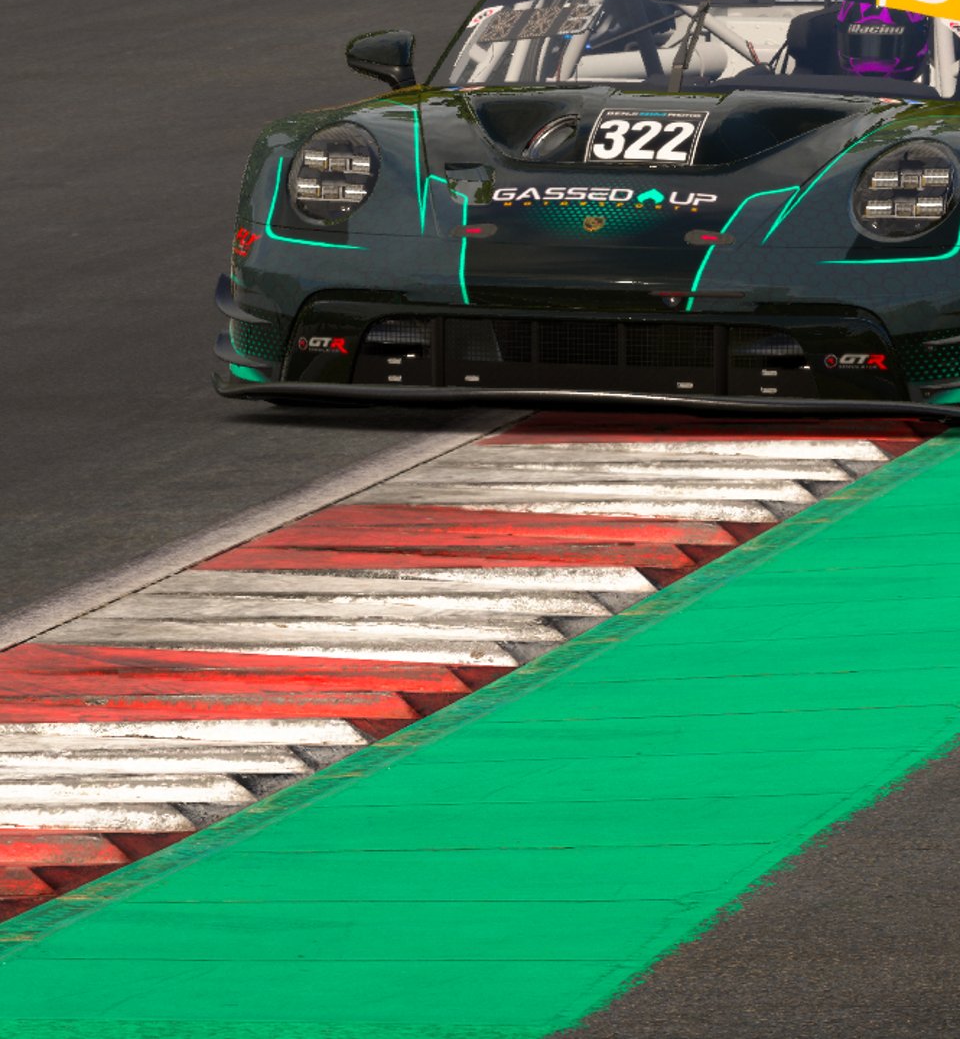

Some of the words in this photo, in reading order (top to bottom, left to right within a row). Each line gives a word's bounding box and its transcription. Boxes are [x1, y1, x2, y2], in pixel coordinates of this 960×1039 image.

[847, 23, 905, 36] iRacing
[592, 119, 697, 162] 322
[491, 186, 634, 202] GASSED
[669, 190, 718, 207] UP
[308, 336, 349, 355] GTR
[839, 353, 889, 371] GTR
